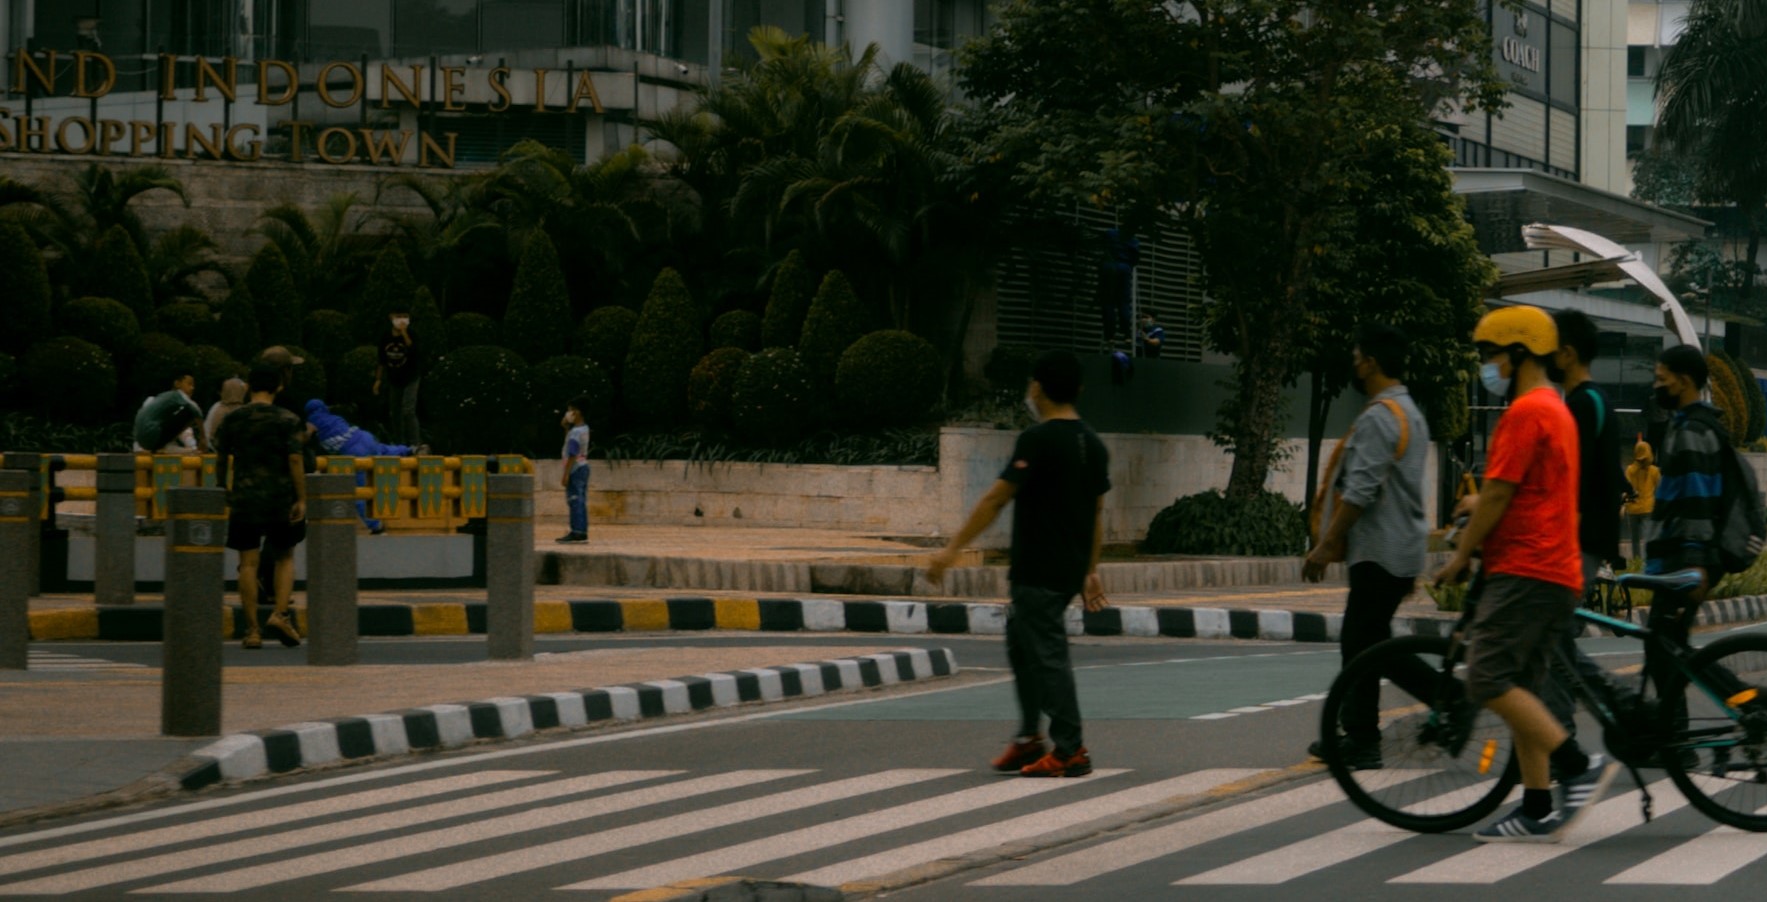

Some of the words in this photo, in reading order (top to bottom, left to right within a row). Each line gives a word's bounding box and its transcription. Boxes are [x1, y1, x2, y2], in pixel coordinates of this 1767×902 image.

[1502, 35, 1540, 73] COACH
[159, 53, 607, 114] INDONESIA
[277, 119, 459, 168] TOWN
